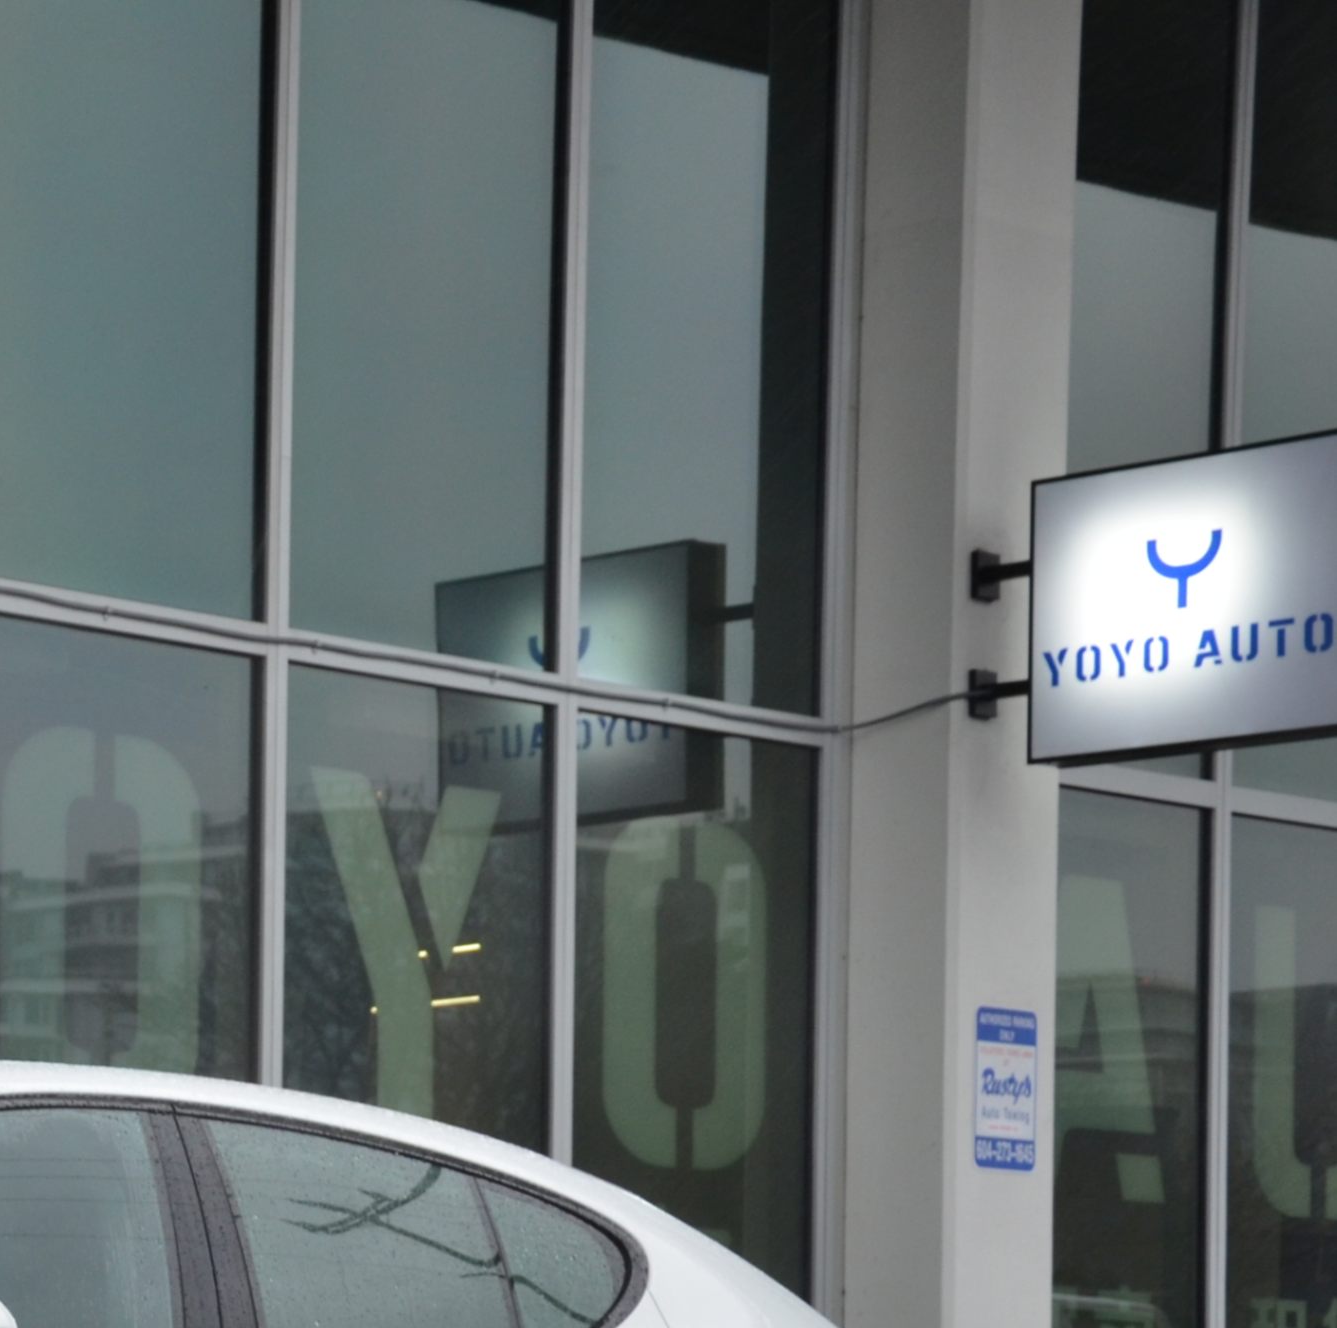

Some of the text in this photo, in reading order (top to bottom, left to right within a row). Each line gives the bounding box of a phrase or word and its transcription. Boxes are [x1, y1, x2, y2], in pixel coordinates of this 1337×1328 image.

[1042, 612, 1335, 687] YOYO AUTO
[981, 1067, 1032, 1104] Rusty's
